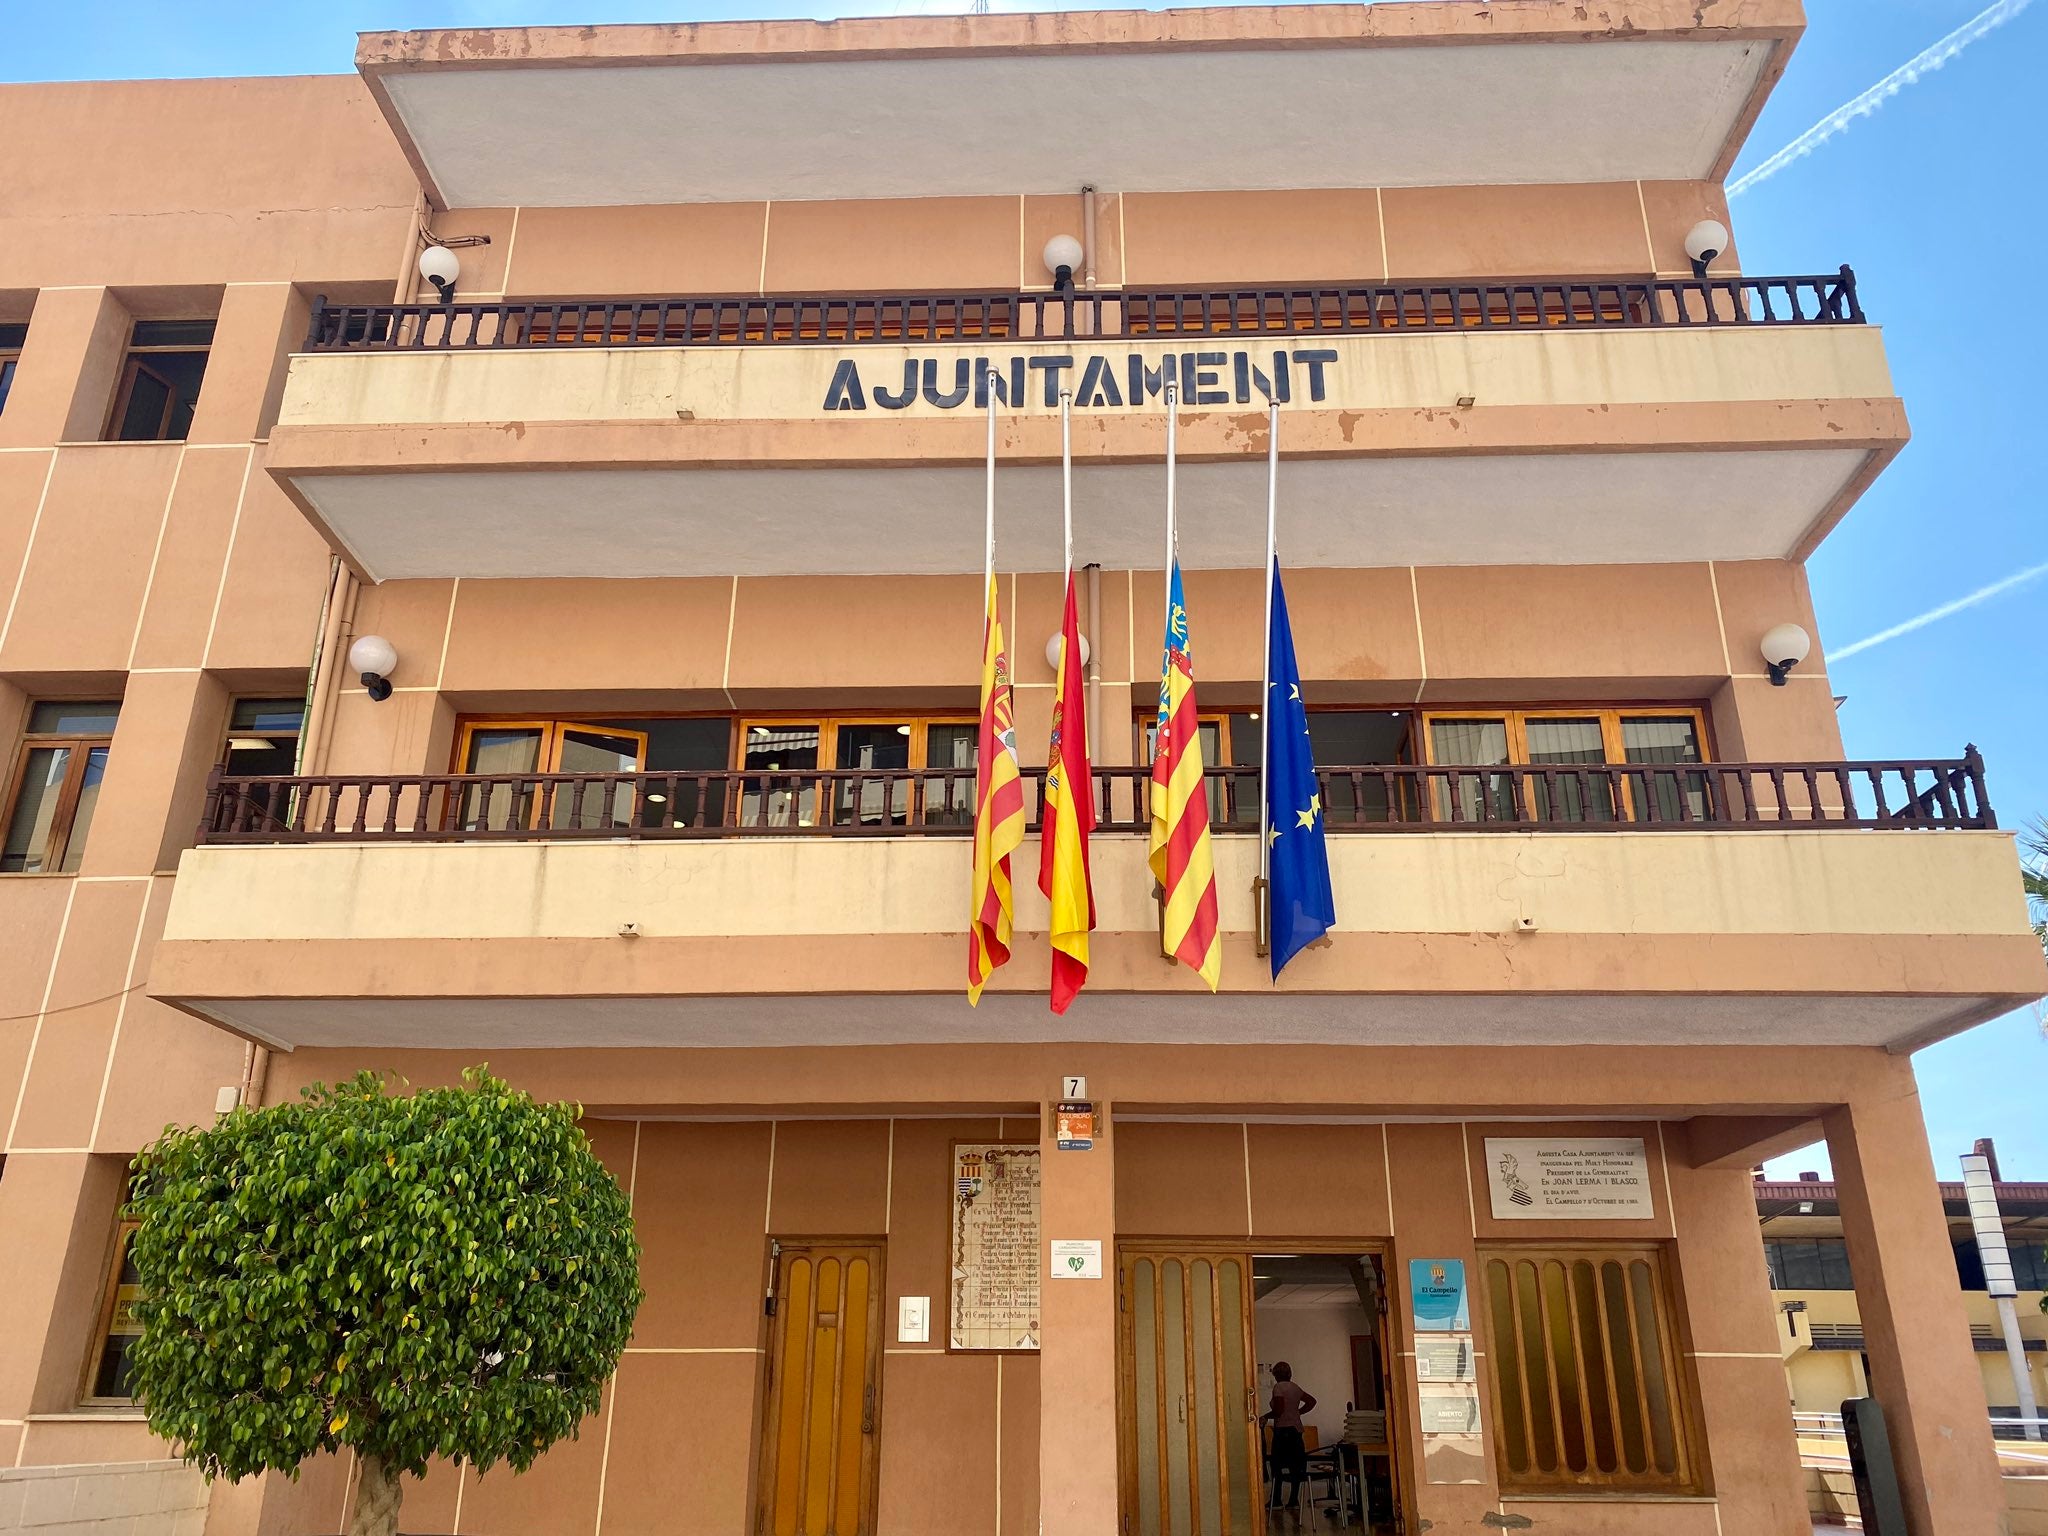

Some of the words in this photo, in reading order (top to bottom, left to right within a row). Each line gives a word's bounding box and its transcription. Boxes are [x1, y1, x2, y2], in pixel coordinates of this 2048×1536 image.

[822, 349, 1338, 411] AJUNTAMENT
[1070, 1079, 1078, 1097] 7
[1562, 1149, 1577, 1157] CASA
[1553, 1178, 1573, 1186] JOAN
[1575, 1178, 1602, 1186] LERMA
[1554, 1197, 1582, 1205] CAMPELLO
